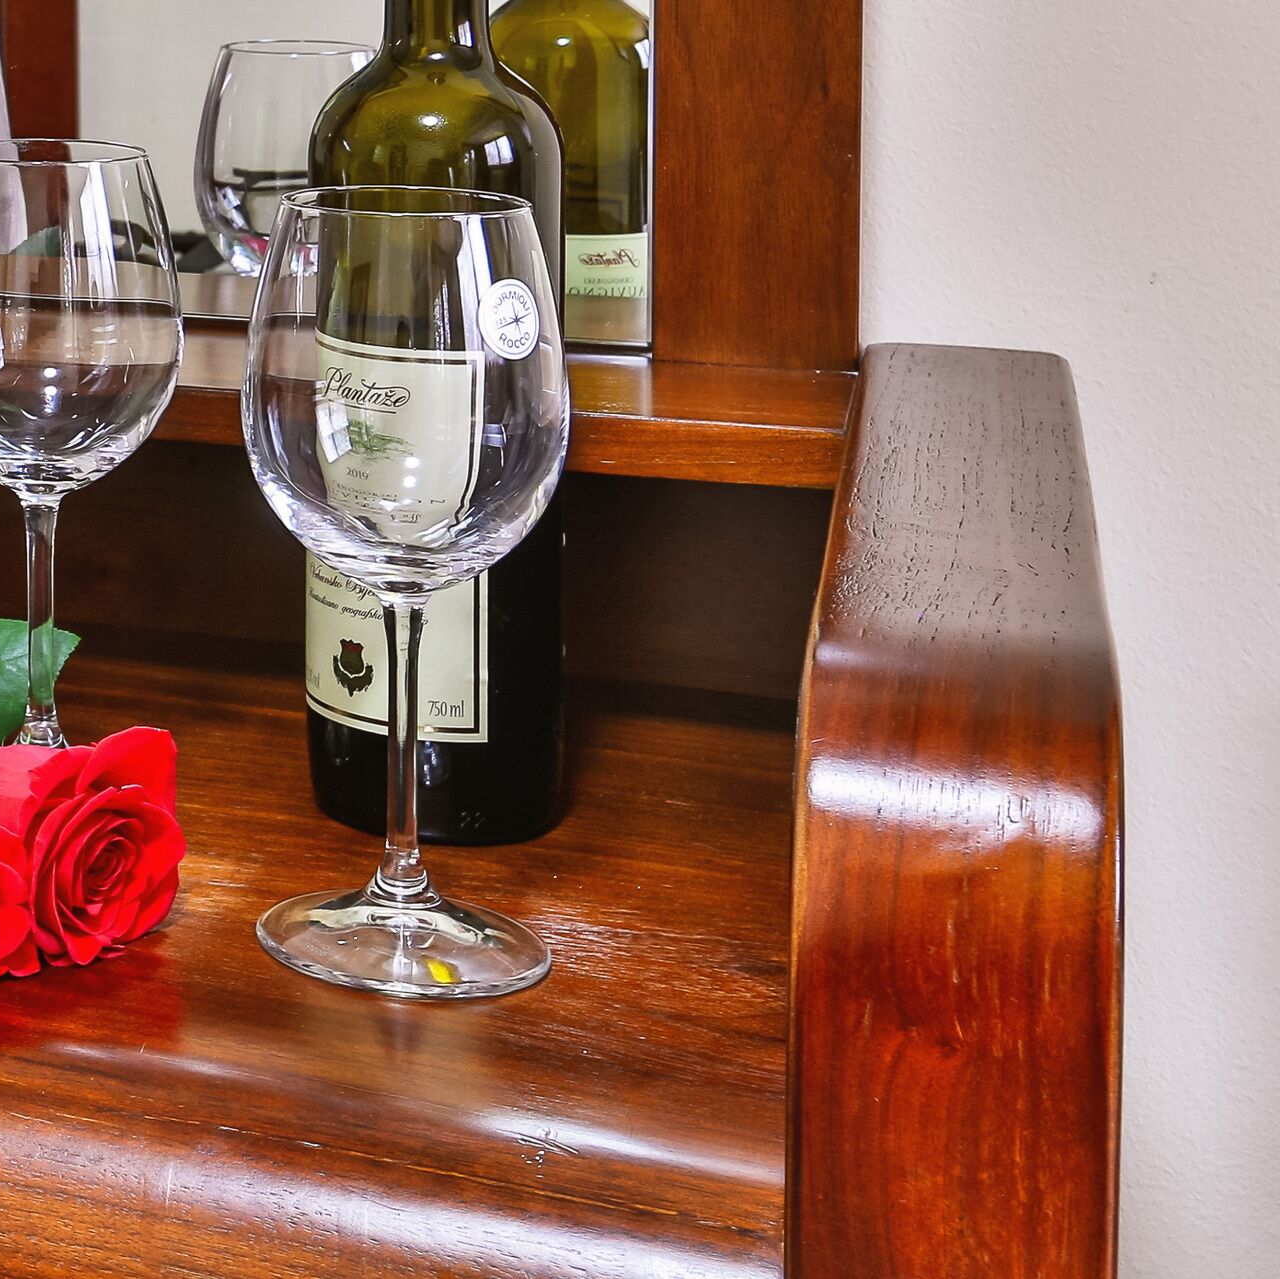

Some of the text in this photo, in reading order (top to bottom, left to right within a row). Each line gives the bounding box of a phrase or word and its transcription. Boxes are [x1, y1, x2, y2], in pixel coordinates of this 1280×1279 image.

[498, 331, 531, 349] ROCCO
[322, 366, 411, 408] Plantaže
[346, 466, 370, 481] 2019
[428, 699, 465, 718] 750 ml
